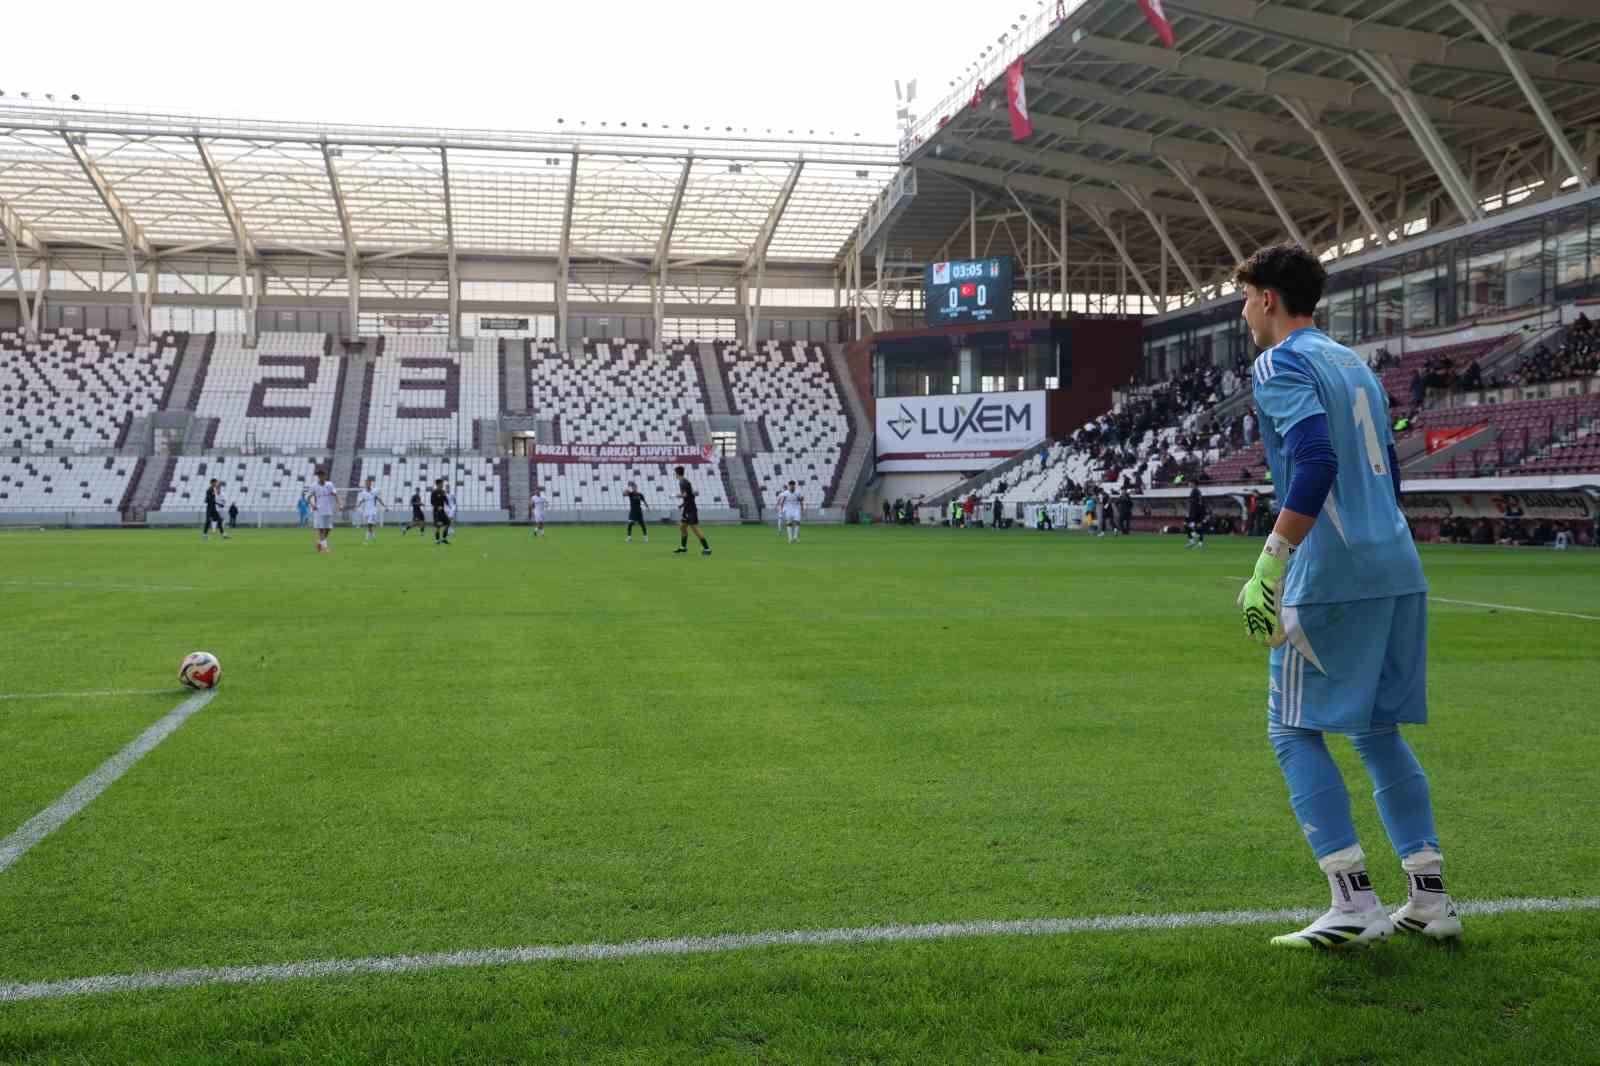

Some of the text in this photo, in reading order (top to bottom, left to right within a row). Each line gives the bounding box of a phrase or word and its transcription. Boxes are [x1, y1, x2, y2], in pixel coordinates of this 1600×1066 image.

[952, 263, 983, 278] 03:05
[949, 284, 987, 308] 0 0
[921, 397, 1031, 442] LUXEM
[1351, 386, 1387, 477] 1
[535, 444, 569, 456] FORZA
[571, 446, 598, 457] KALE
[600, 446, 638, 457] ARKASI
